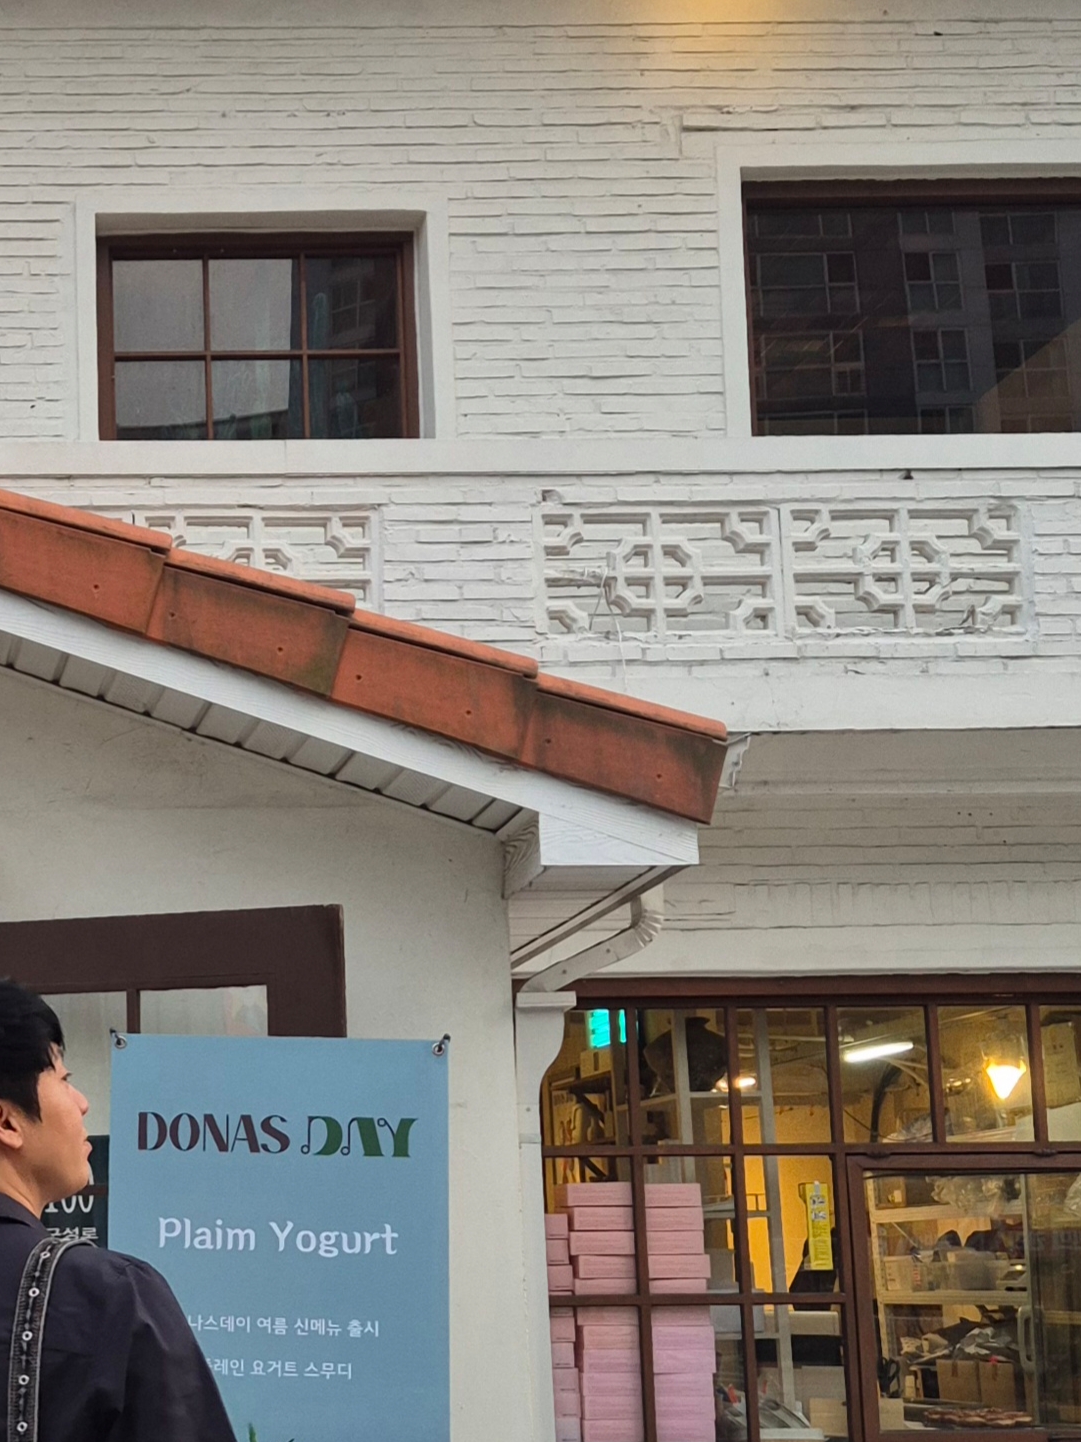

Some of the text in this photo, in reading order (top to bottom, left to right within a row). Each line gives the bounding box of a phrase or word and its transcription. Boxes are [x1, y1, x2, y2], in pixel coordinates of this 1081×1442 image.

[137, 1111, 419, 1157] DONAS DAY
[158, 1217, 399, 1257] Plaim Yogurt
[187, 1314, 380, 1338] 나스데이 여름 신메뉴 출시
[250, 1360, 298, 1378] 요거트
[304, 1362, 352, 1380] 스무디
